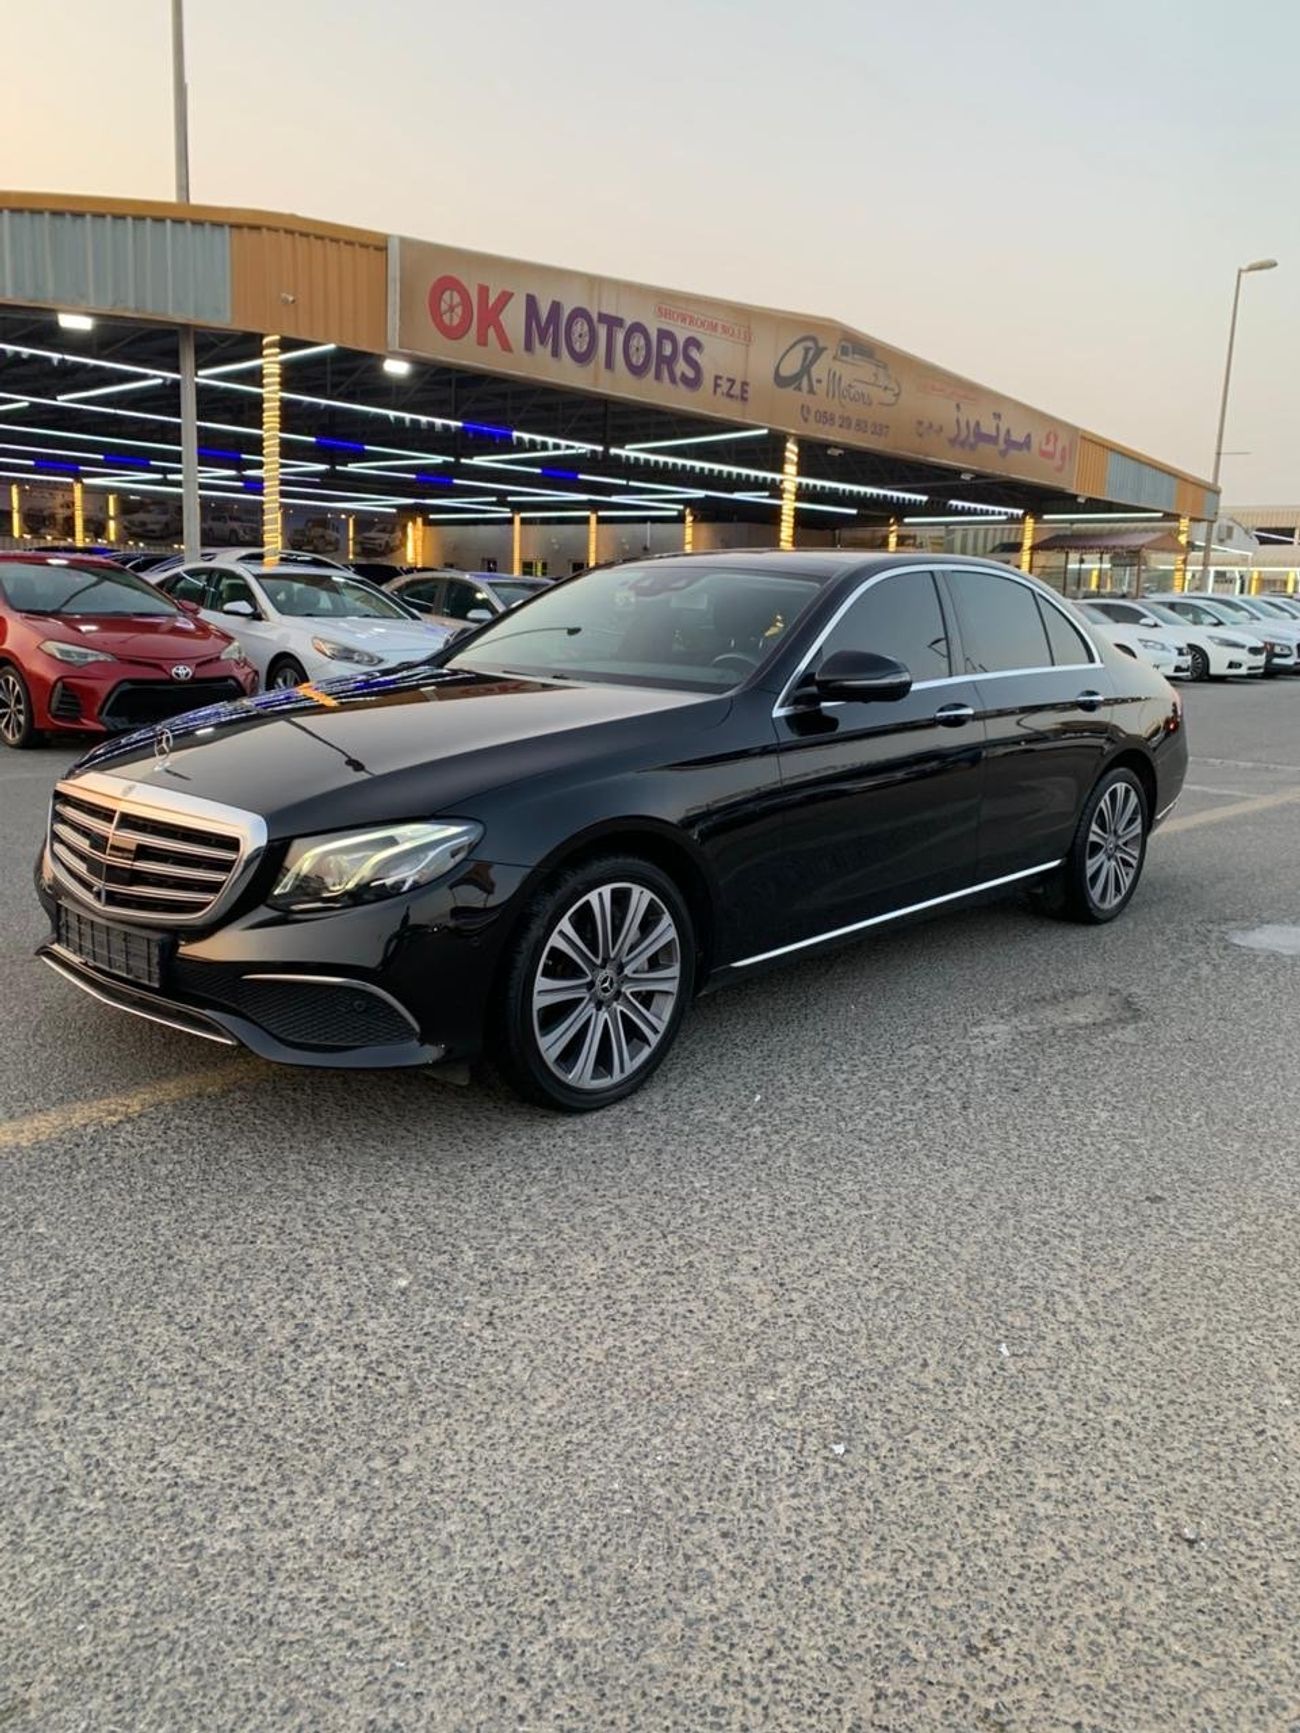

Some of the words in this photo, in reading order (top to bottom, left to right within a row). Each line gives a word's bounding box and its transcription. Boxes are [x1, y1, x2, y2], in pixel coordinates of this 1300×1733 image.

[427, 274, 515, 353] OK
[523, 293, 705, 393] MOTORS
[656, 305, 718, 333] SHOWROOM
